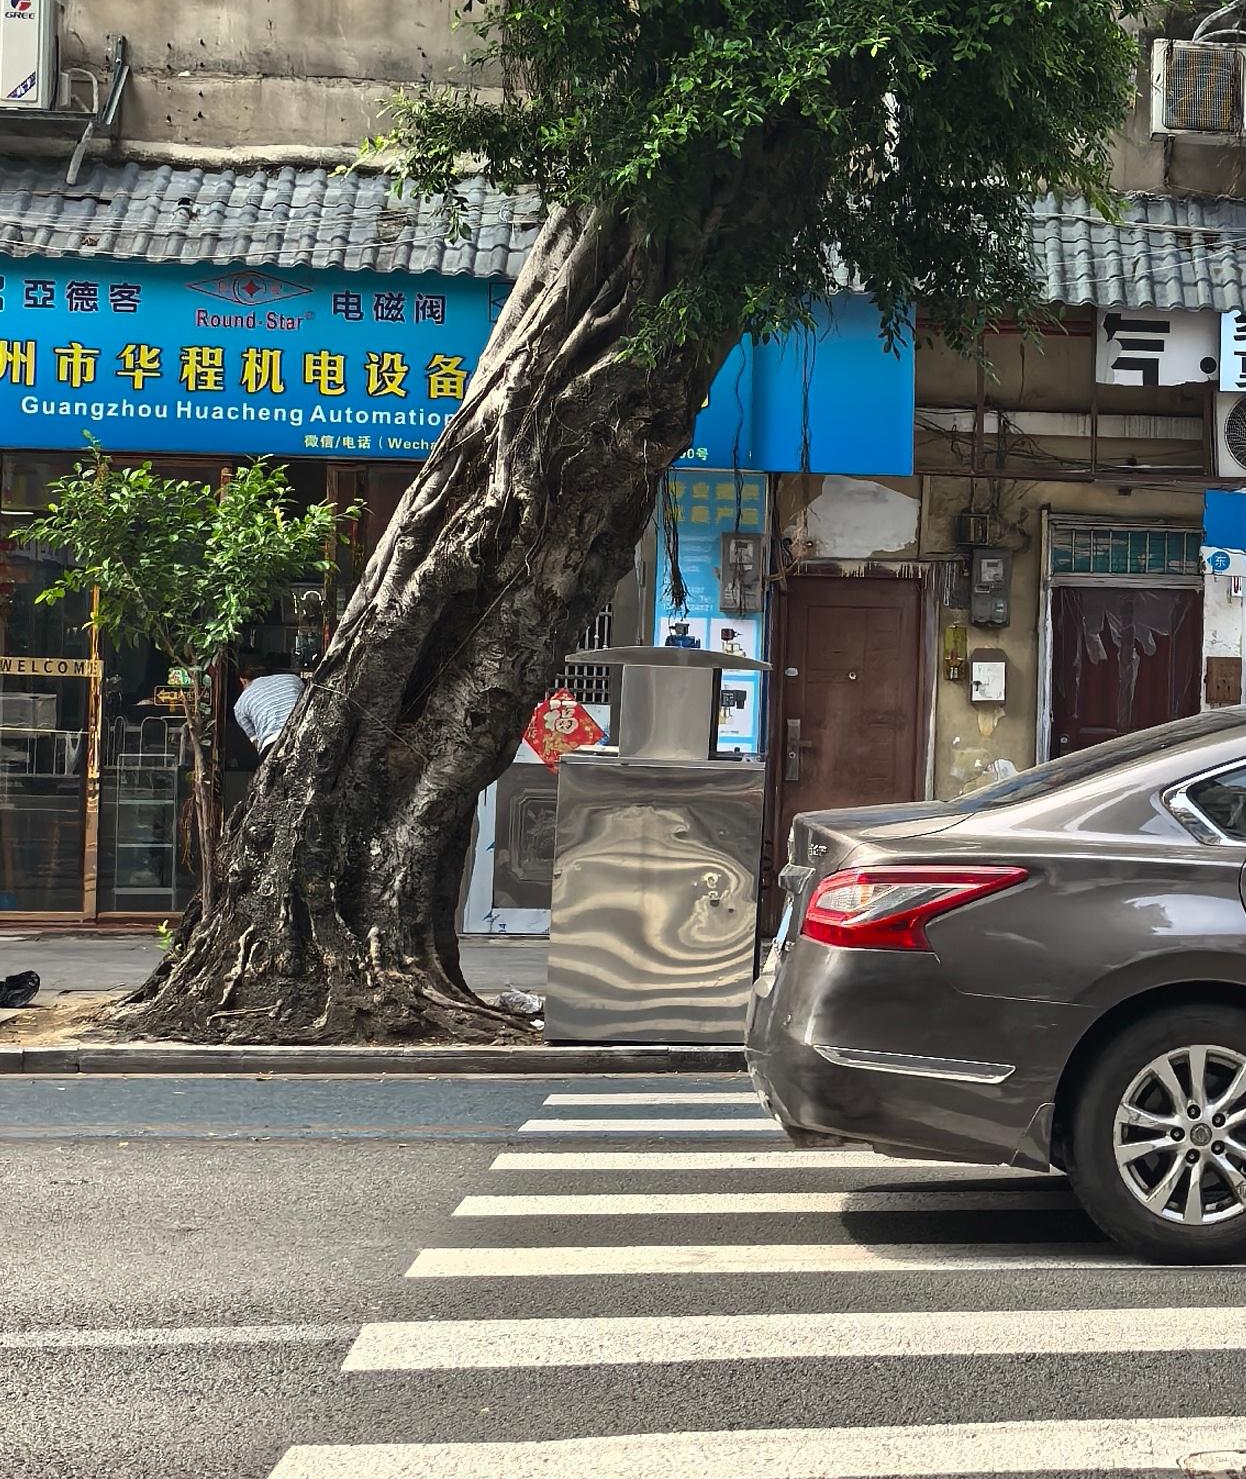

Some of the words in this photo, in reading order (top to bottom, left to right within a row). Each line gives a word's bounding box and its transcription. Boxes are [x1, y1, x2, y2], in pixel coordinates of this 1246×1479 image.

[0, 275, 142, 313] 亞德客
[332, 290, 447, 324] 电磁阀
[21, 396, 168, 420] Guangzhou
[176, 401, 303, 425] Huacheng
[543, 699, 579, 734] 福
